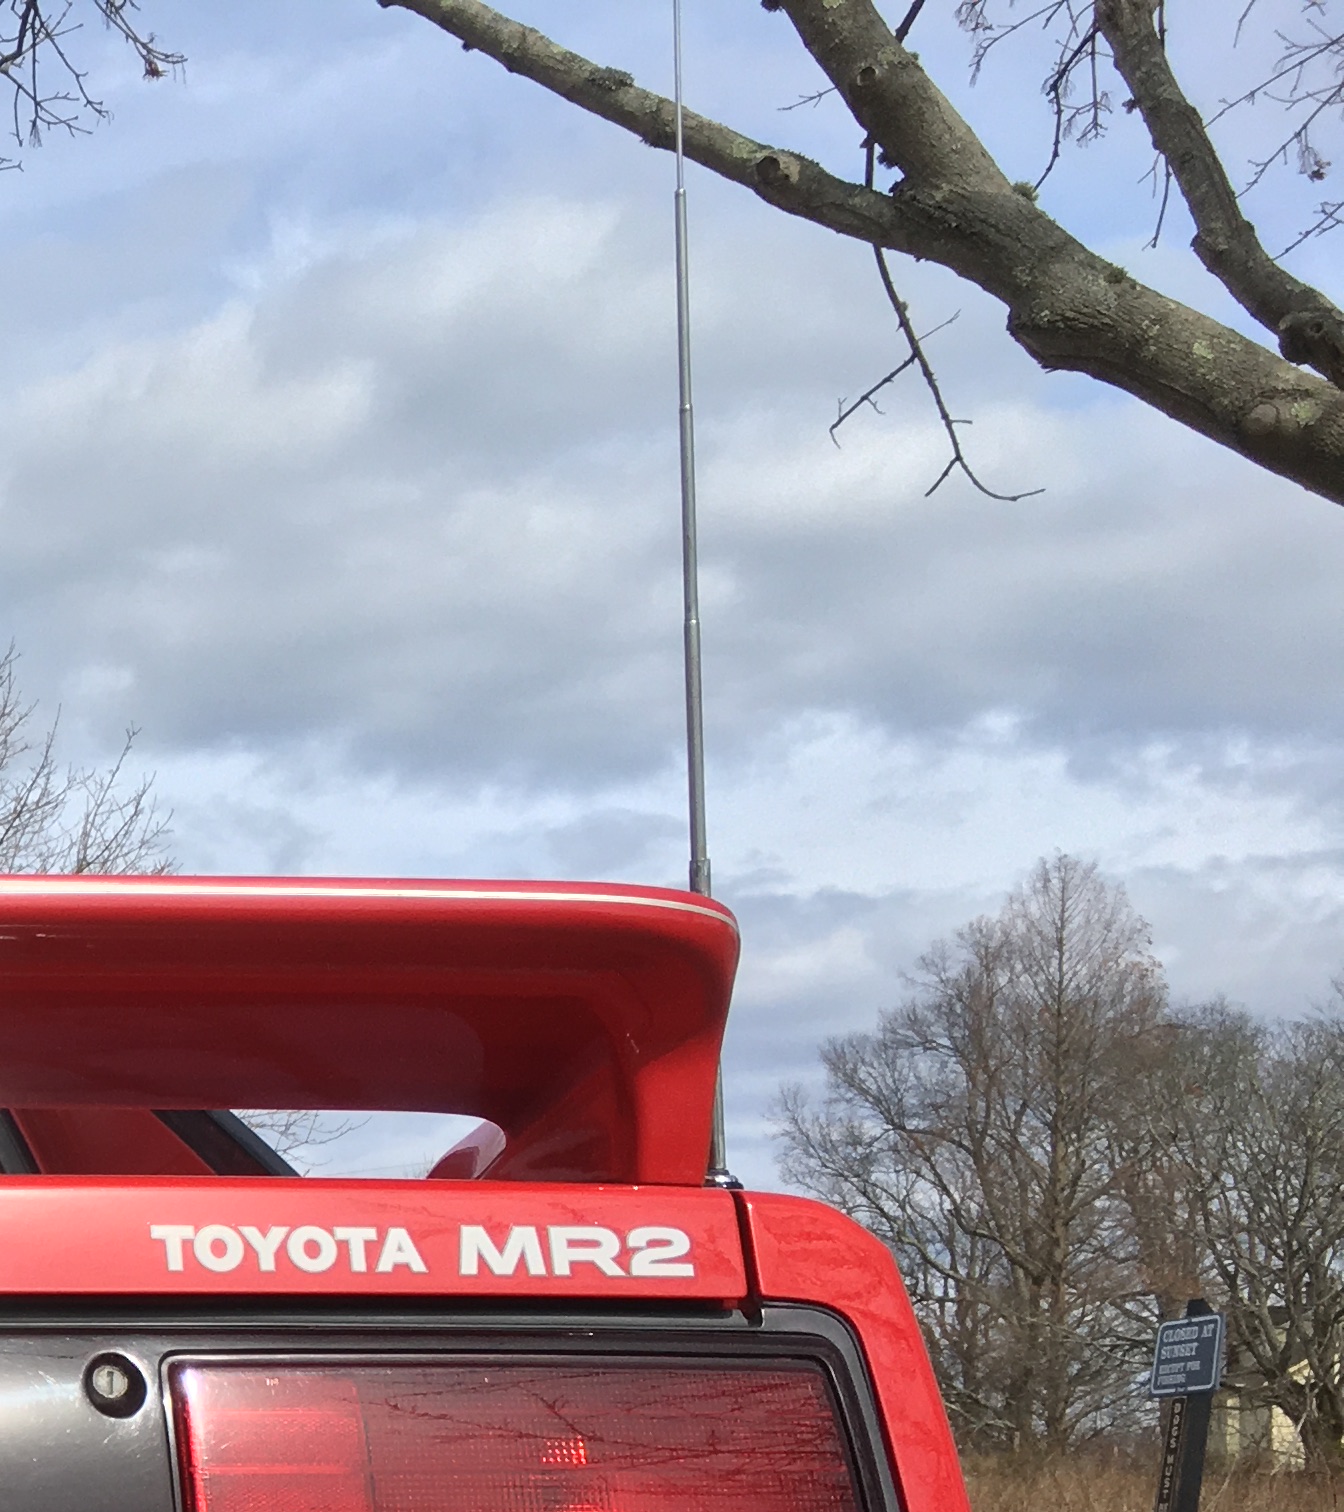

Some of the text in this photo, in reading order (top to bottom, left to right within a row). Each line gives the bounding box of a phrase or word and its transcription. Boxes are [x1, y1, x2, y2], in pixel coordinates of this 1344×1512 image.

[150, 1224, 695, 1277] TOYOTA MR2
[1160, 1342, 1200, 1360] SUNSET
[1163, 1323, 1215, 1343] CLOSED AT
[1170, 1402, 1182, 1449] DOGS
[1162, 1454, 1175, 1499] MUST
